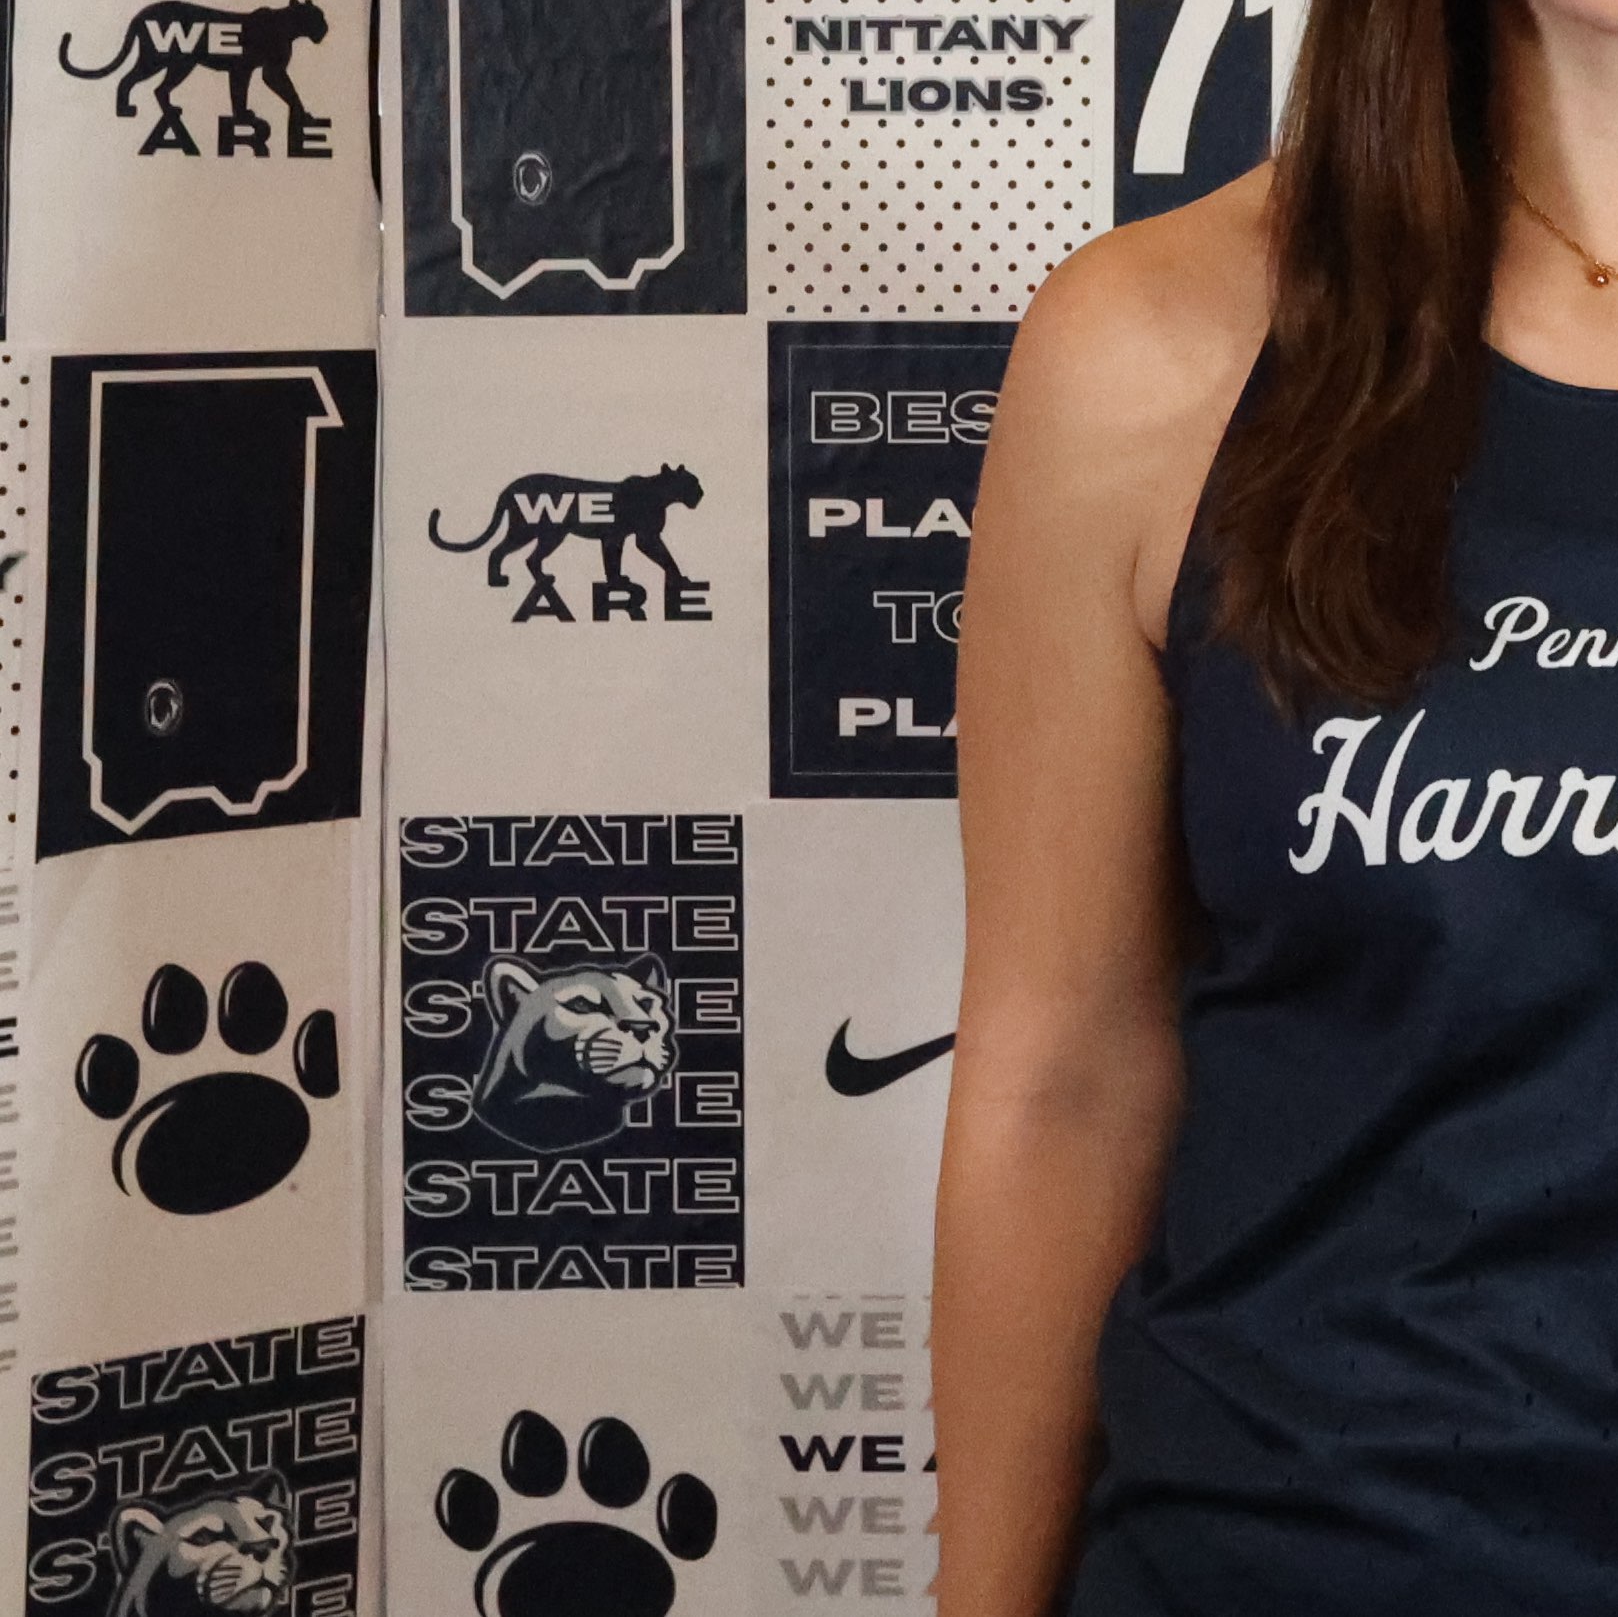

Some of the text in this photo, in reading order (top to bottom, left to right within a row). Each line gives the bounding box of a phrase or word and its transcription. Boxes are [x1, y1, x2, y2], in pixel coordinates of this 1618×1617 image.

[145, 20, 243, 55] WE
[795, 15, 1086, 51] NITTANY
[847, 78, 1044, 114] LIONS
[137, 116, 332, 158] ARE
[811, 390, 1000, 444] BES
[514, 492, 615, 524] WE
[809, 497, 974, 538] PLA
[511, 580, 713, 623] ARE
[401, 814, 738, 867] STATE
[402, 896, 739, 955] STATE
[404, 1158, 739, 1217] STATE
[405, 1245, 740, 1291] STATE
[779, 1311, 906, 1350] WE
[32, 1314, 360, 1425] STATE
[779, 1373, 906, 1411] WE
[30, 1397, 357, 1516] STATE
[779, 1435, 906, 1473] WE
[779, 1496, 906, 1534] WE
[778, 1558, 905, 1597] WE
